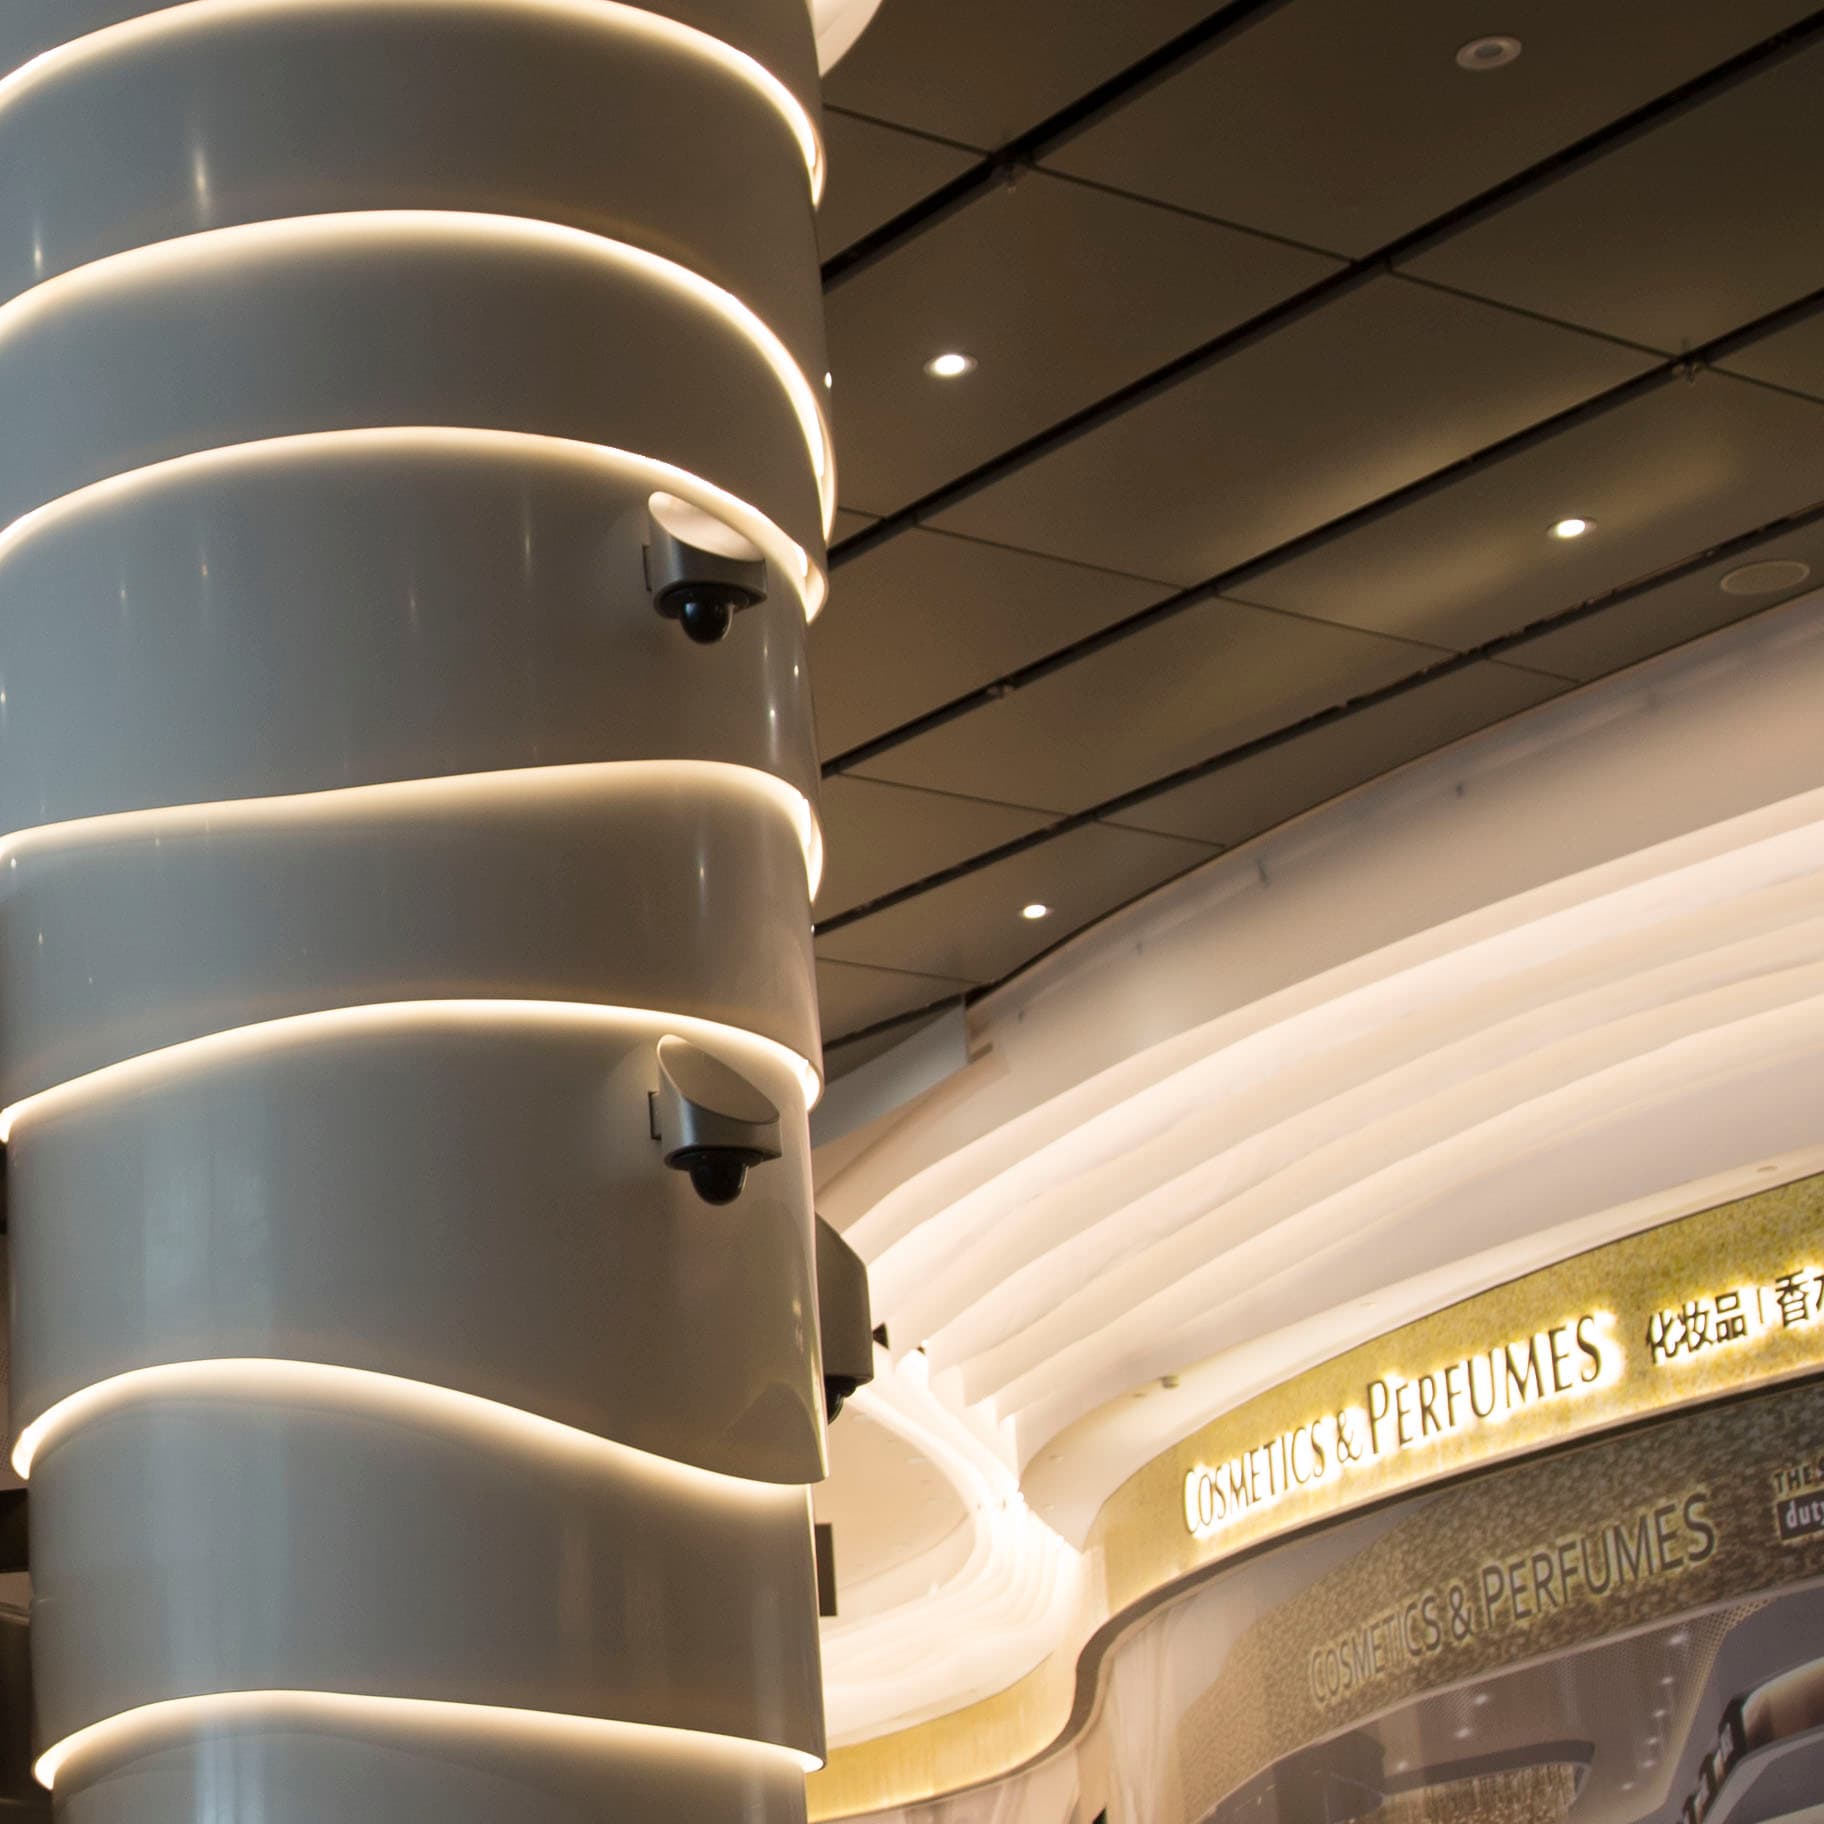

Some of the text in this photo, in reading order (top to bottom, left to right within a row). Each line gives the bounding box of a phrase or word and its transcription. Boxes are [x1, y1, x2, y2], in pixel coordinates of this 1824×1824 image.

[1183, 1313, 1603, 1536] COSMETICS & PERFUMES
[1309, 1491, 1717, 1704] COSMETICS & PERFUMES
